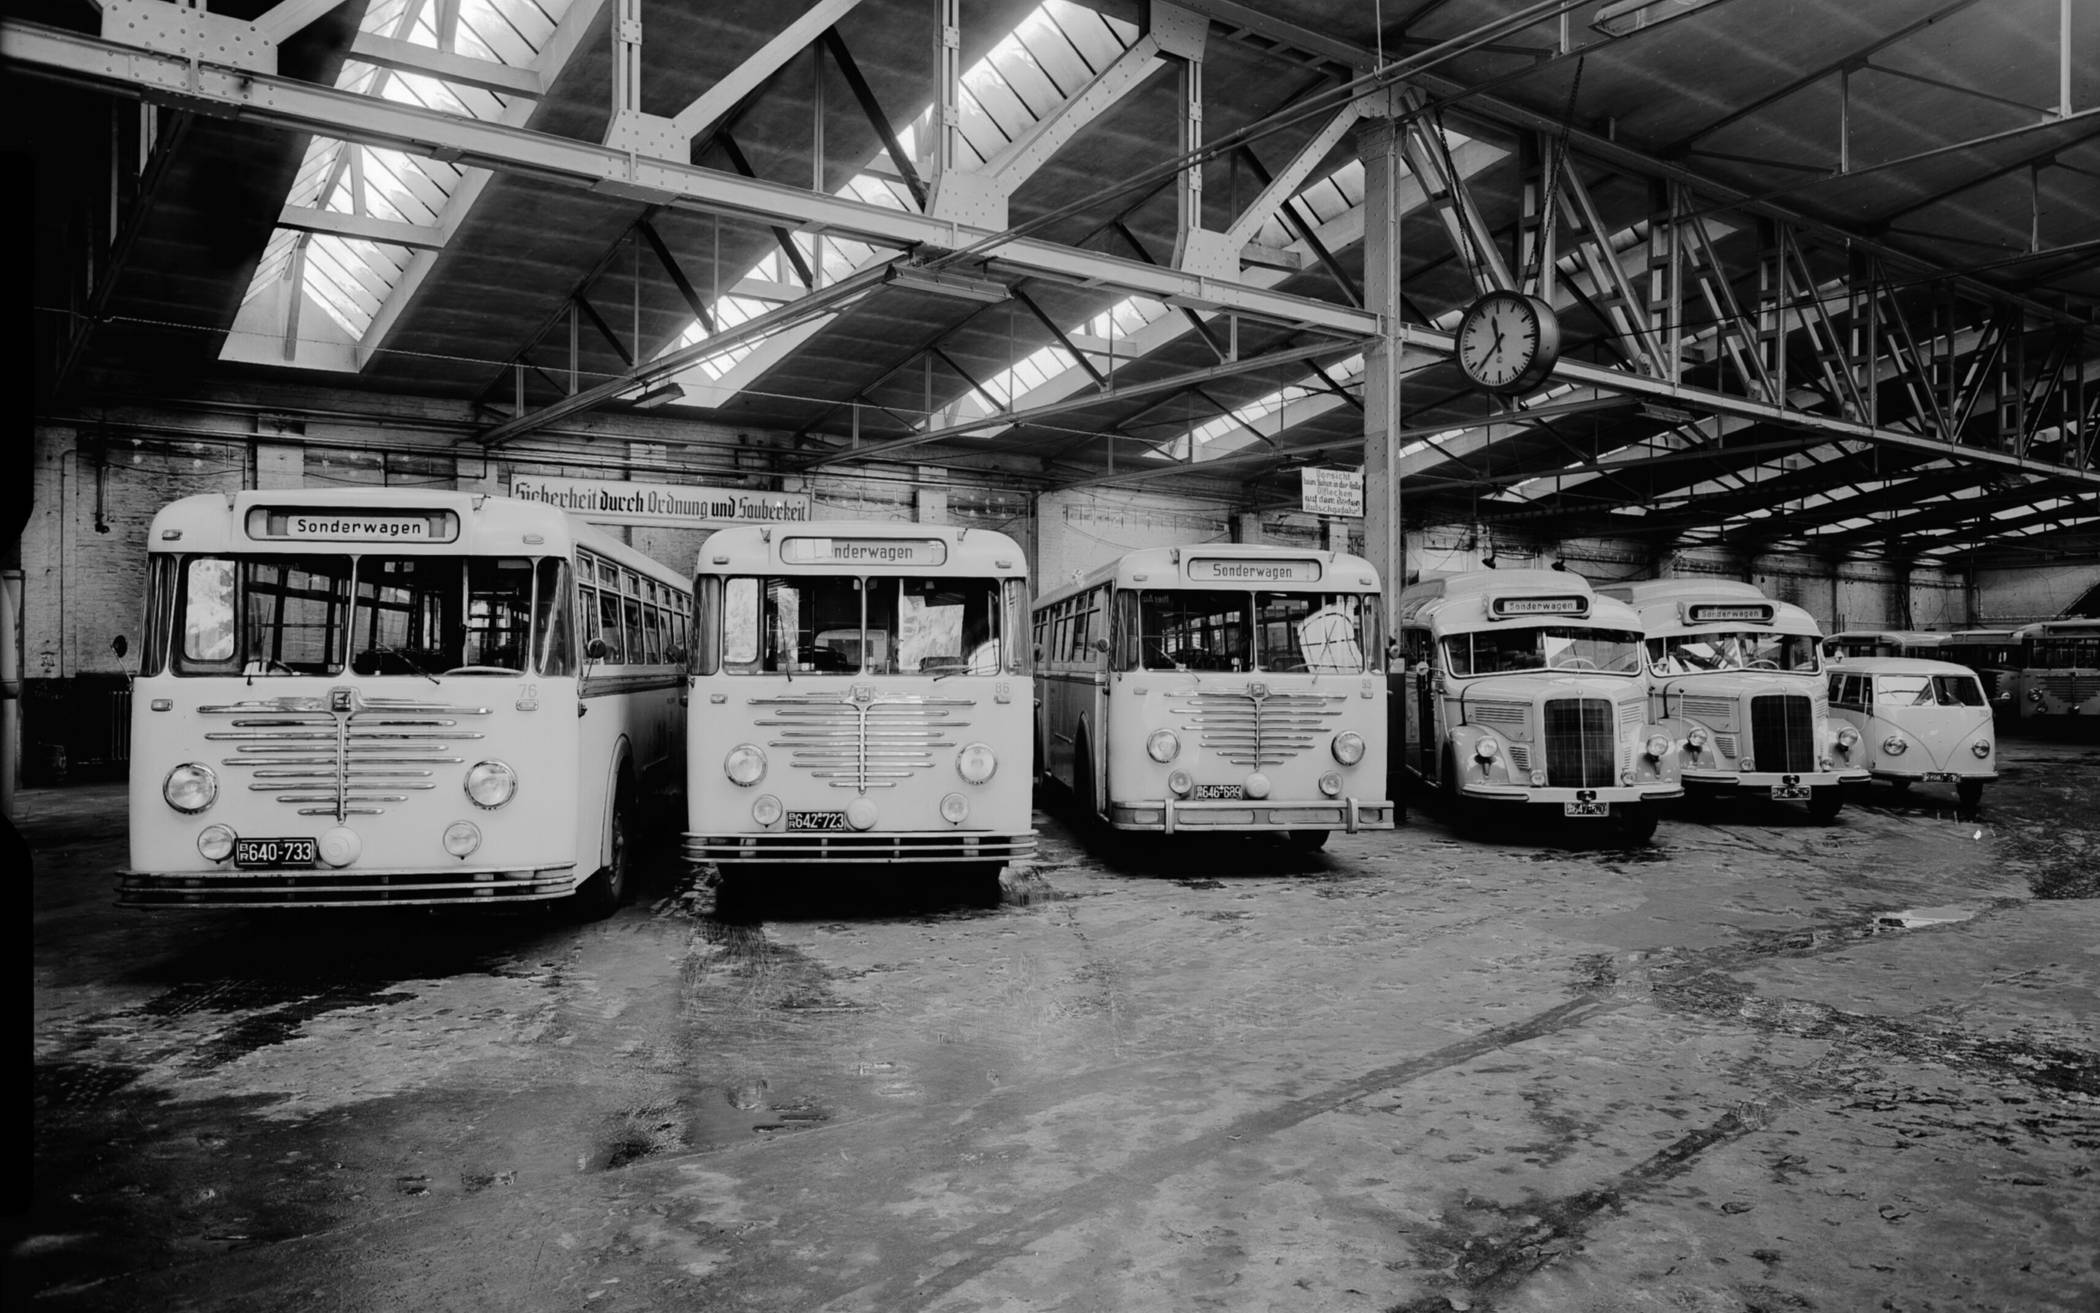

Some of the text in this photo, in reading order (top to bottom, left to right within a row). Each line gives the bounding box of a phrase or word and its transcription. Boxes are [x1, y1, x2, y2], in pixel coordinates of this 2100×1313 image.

[515, 482, 806, 522] Sicherheit durch Ordnung und Sauberkeit
[298, 519, 421, 536] Sonderwagen
[832, 543, 913, 561] nderwagen
[1213, 563, 1292, 580] Sonderwagen
[1509, 602, 1573, 612] Sonderwagen
[517, 683, 537, 698] 76
[249, 843, 311, 861] 640-733
